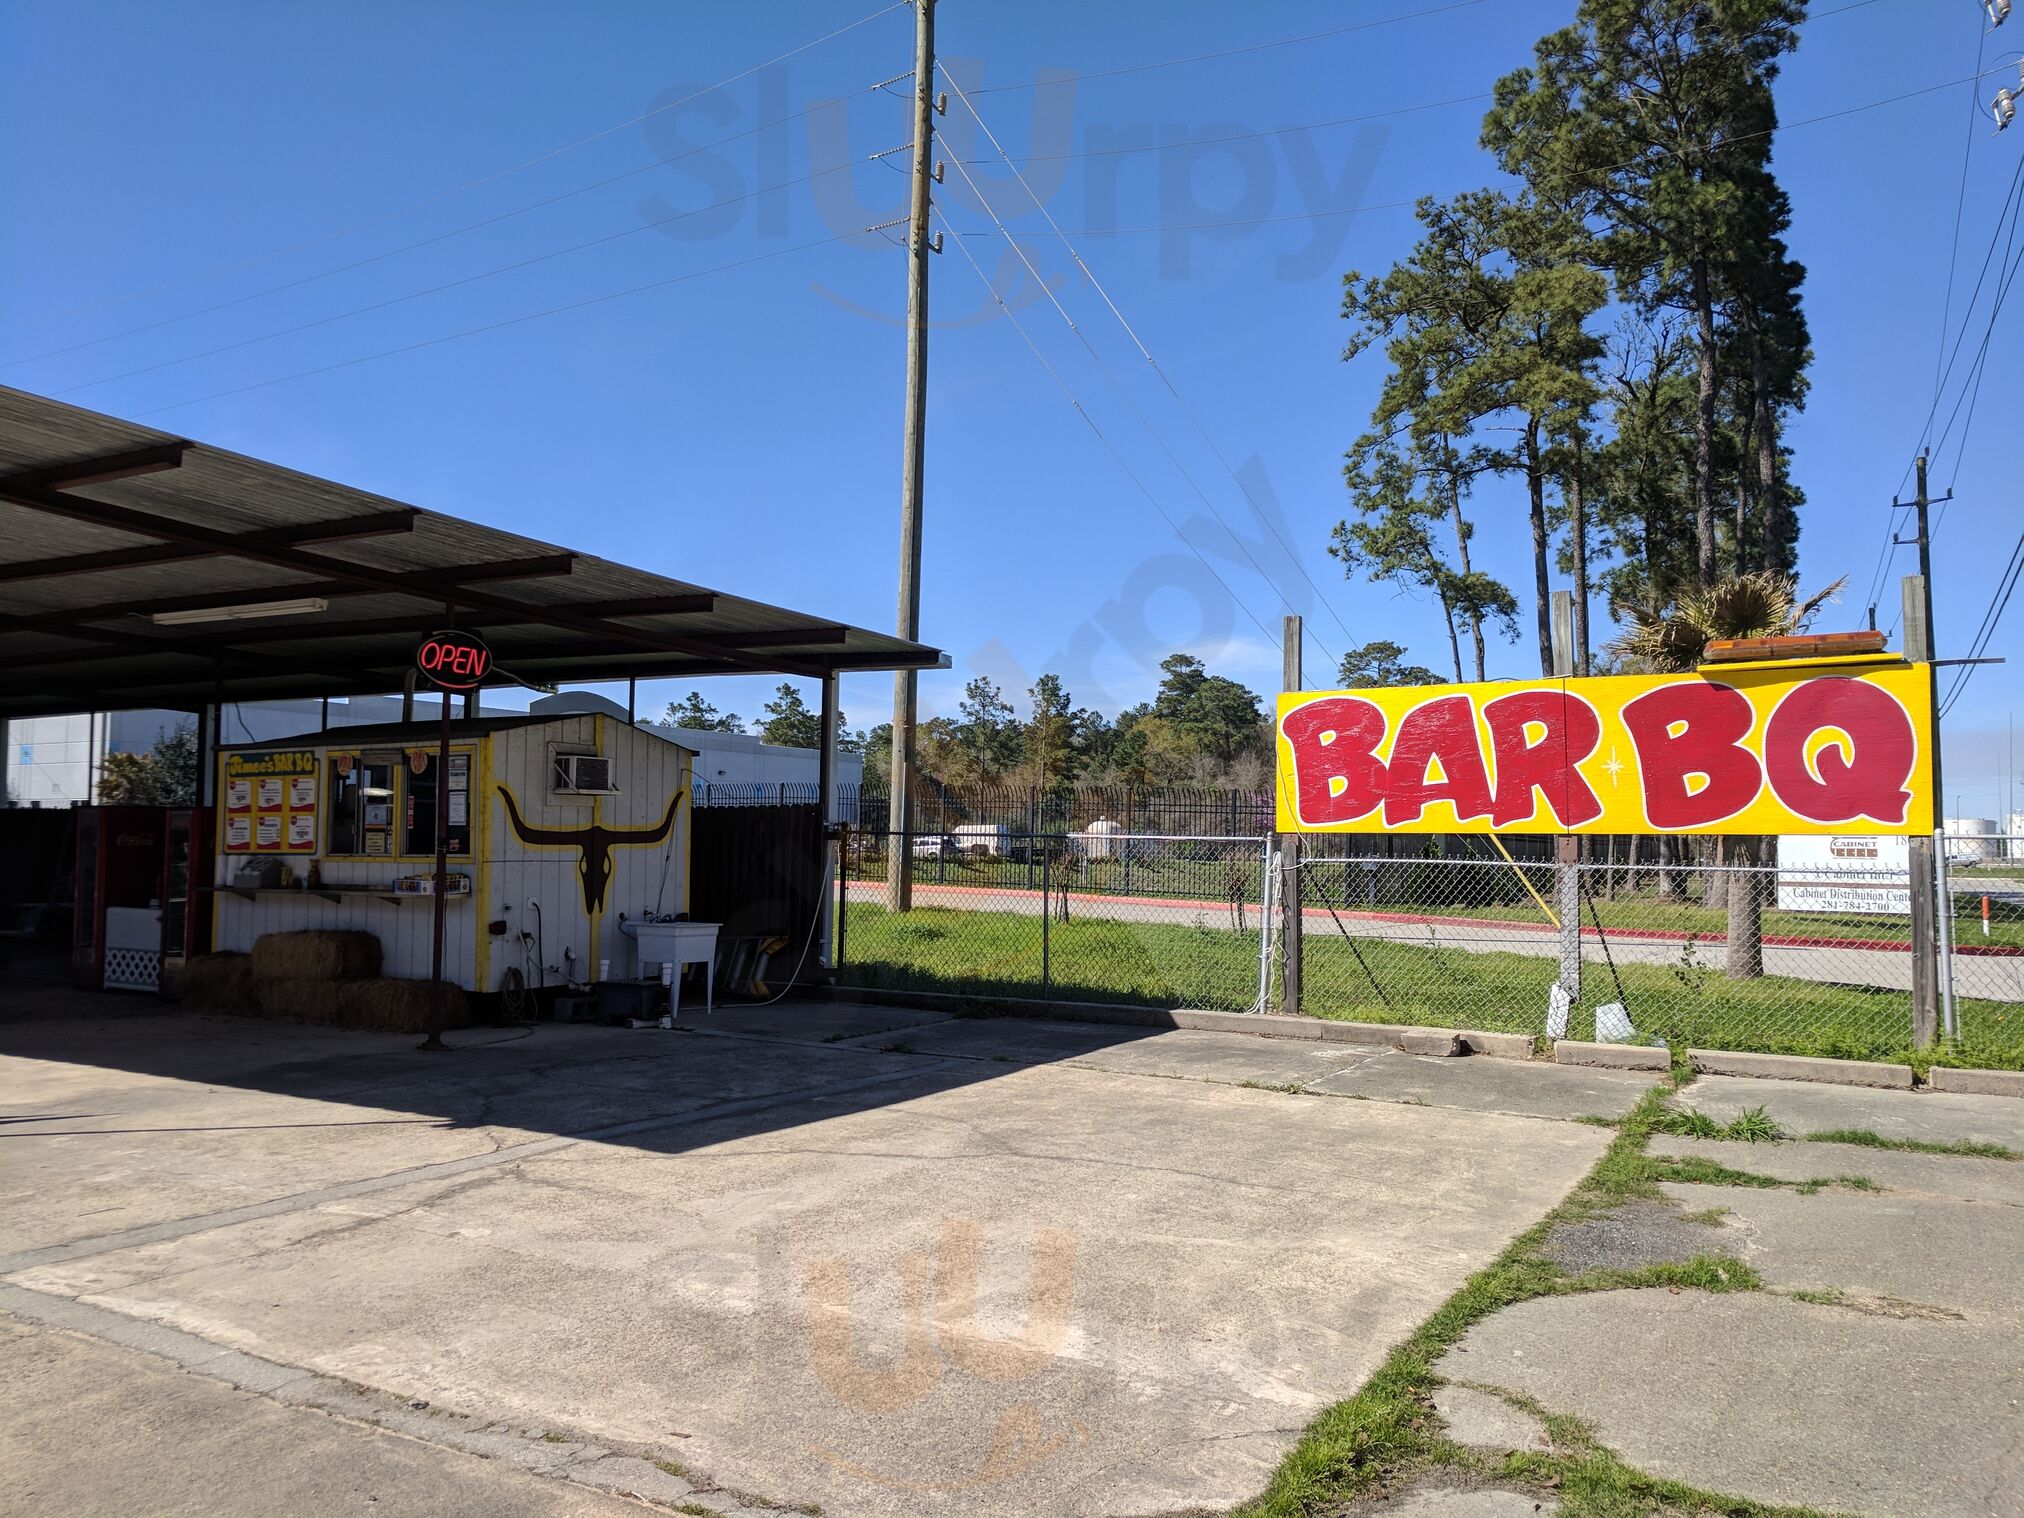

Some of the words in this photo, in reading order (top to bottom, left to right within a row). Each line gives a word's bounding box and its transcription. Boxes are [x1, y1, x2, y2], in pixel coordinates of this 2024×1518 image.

[421, 642, 487, 676] OPEN
[1281, 690, 1606, 829] BAR
[1621, 676, 1916, 829] BQ
[1793, 887, 1827, 899] Cabinet
[1830, 888, 1884, 901] Distribution
